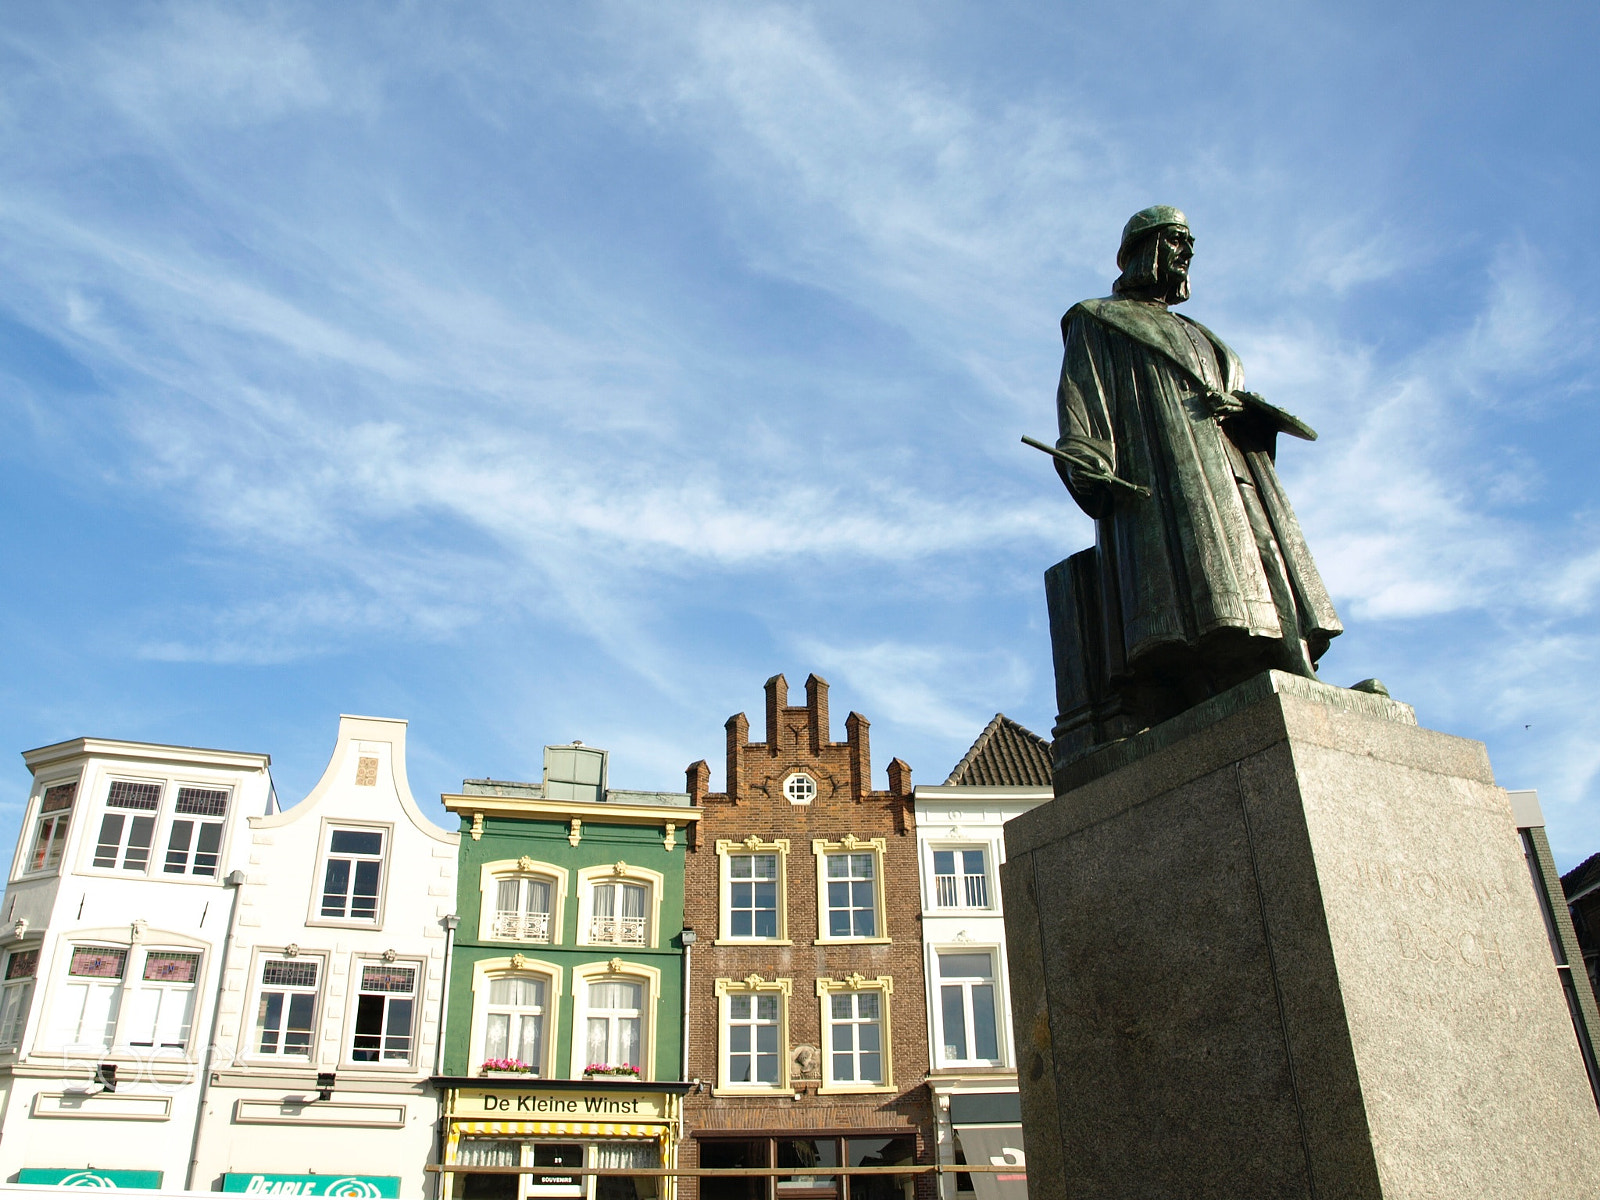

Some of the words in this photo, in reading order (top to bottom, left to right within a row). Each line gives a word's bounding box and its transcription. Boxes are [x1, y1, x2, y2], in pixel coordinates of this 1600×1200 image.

[1393, 920, 1506, 972] BOSCH
[483, 1094, 510, 1112] De
[517, 1095, 578, 1113] Kleine
[584, 1096, 639, 1114] Winst
